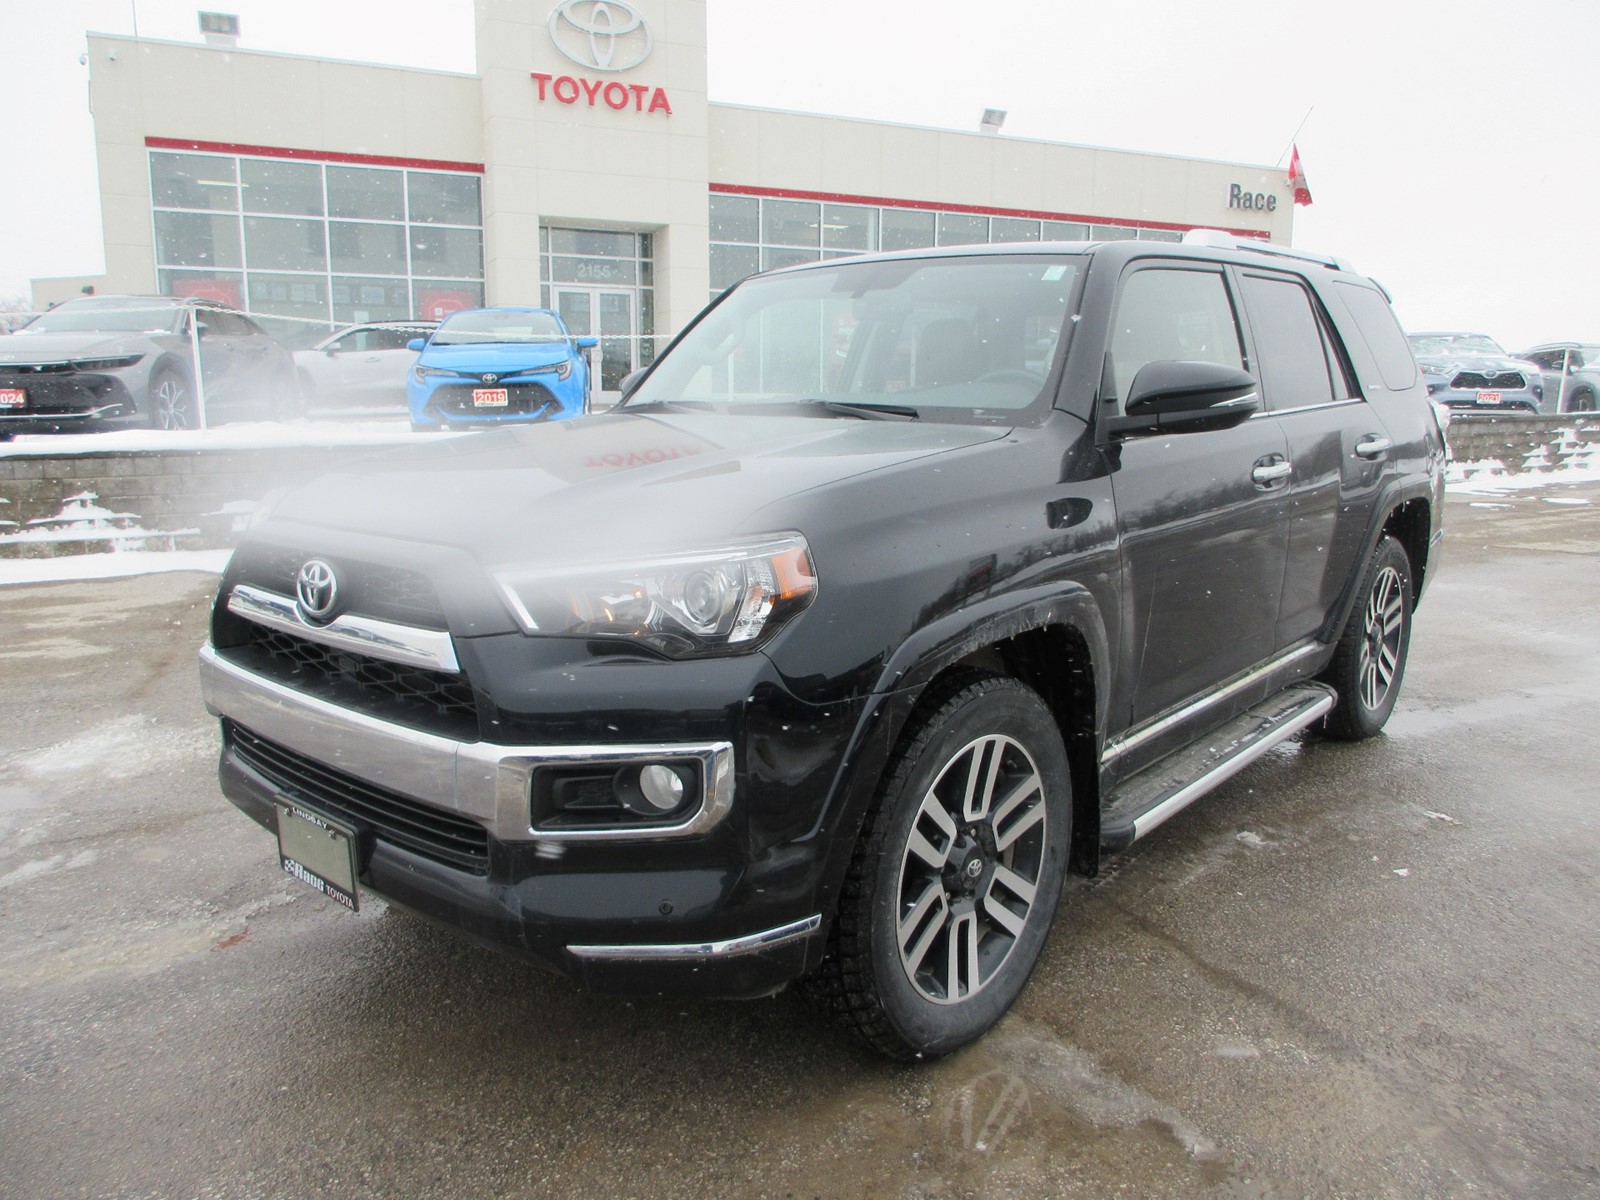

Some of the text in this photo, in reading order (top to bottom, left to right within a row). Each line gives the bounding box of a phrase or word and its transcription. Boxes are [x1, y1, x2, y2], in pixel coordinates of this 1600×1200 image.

[530, 72, 672, 115] TOYOTA
[1229, 183, 1276, 212] Race
[577, 263, 611, 279] 2155
[476, 393, 505, 403] 2019
[292, 806, 328, 829] LINDSAY
[326, 884, 355, 910] TOYOTA
